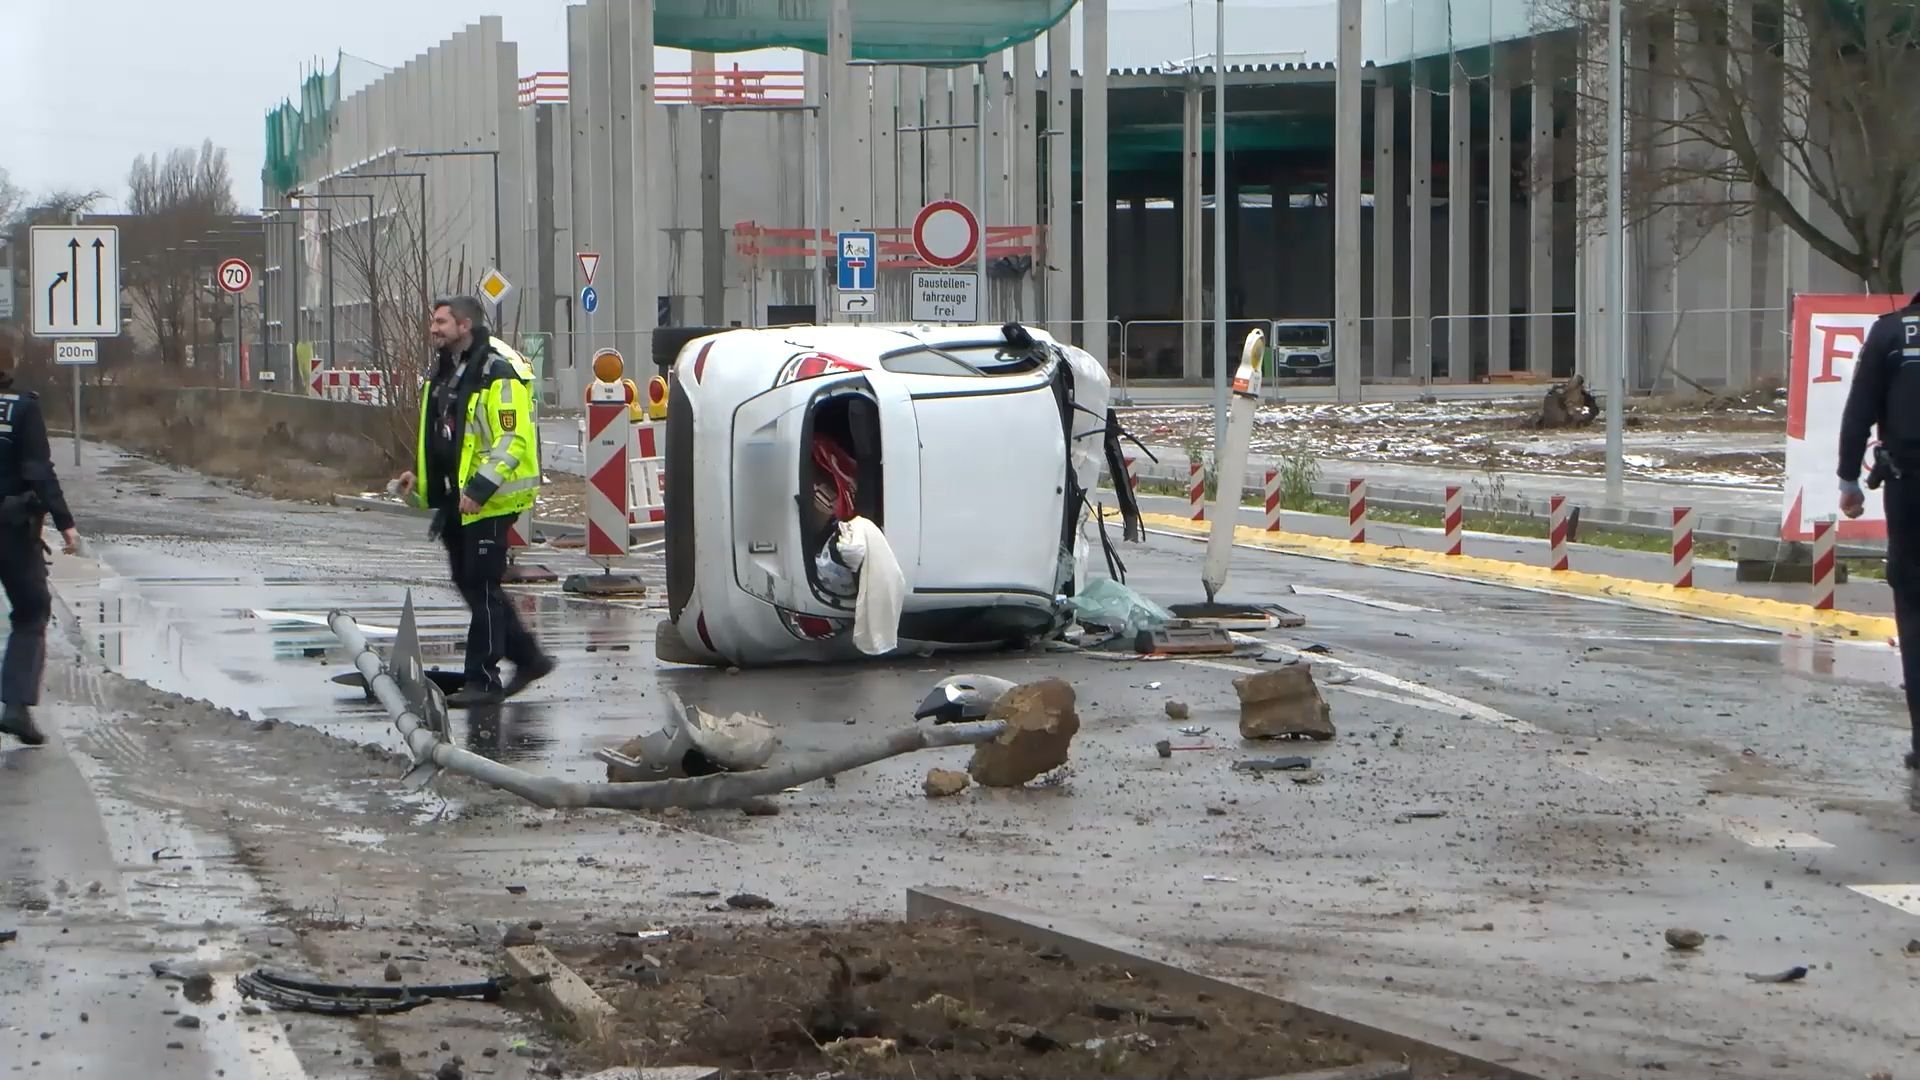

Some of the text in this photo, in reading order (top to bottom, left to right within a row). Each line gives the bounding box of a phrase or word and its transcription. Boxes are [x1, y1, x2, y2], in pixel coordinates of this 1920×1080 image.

[226, 269, 244, 284] 70
[918, 277, 971, 288] Baustellen-
[922, 291, 967, 305] fahrzeuge
[934, 305, 955, 316] frei
